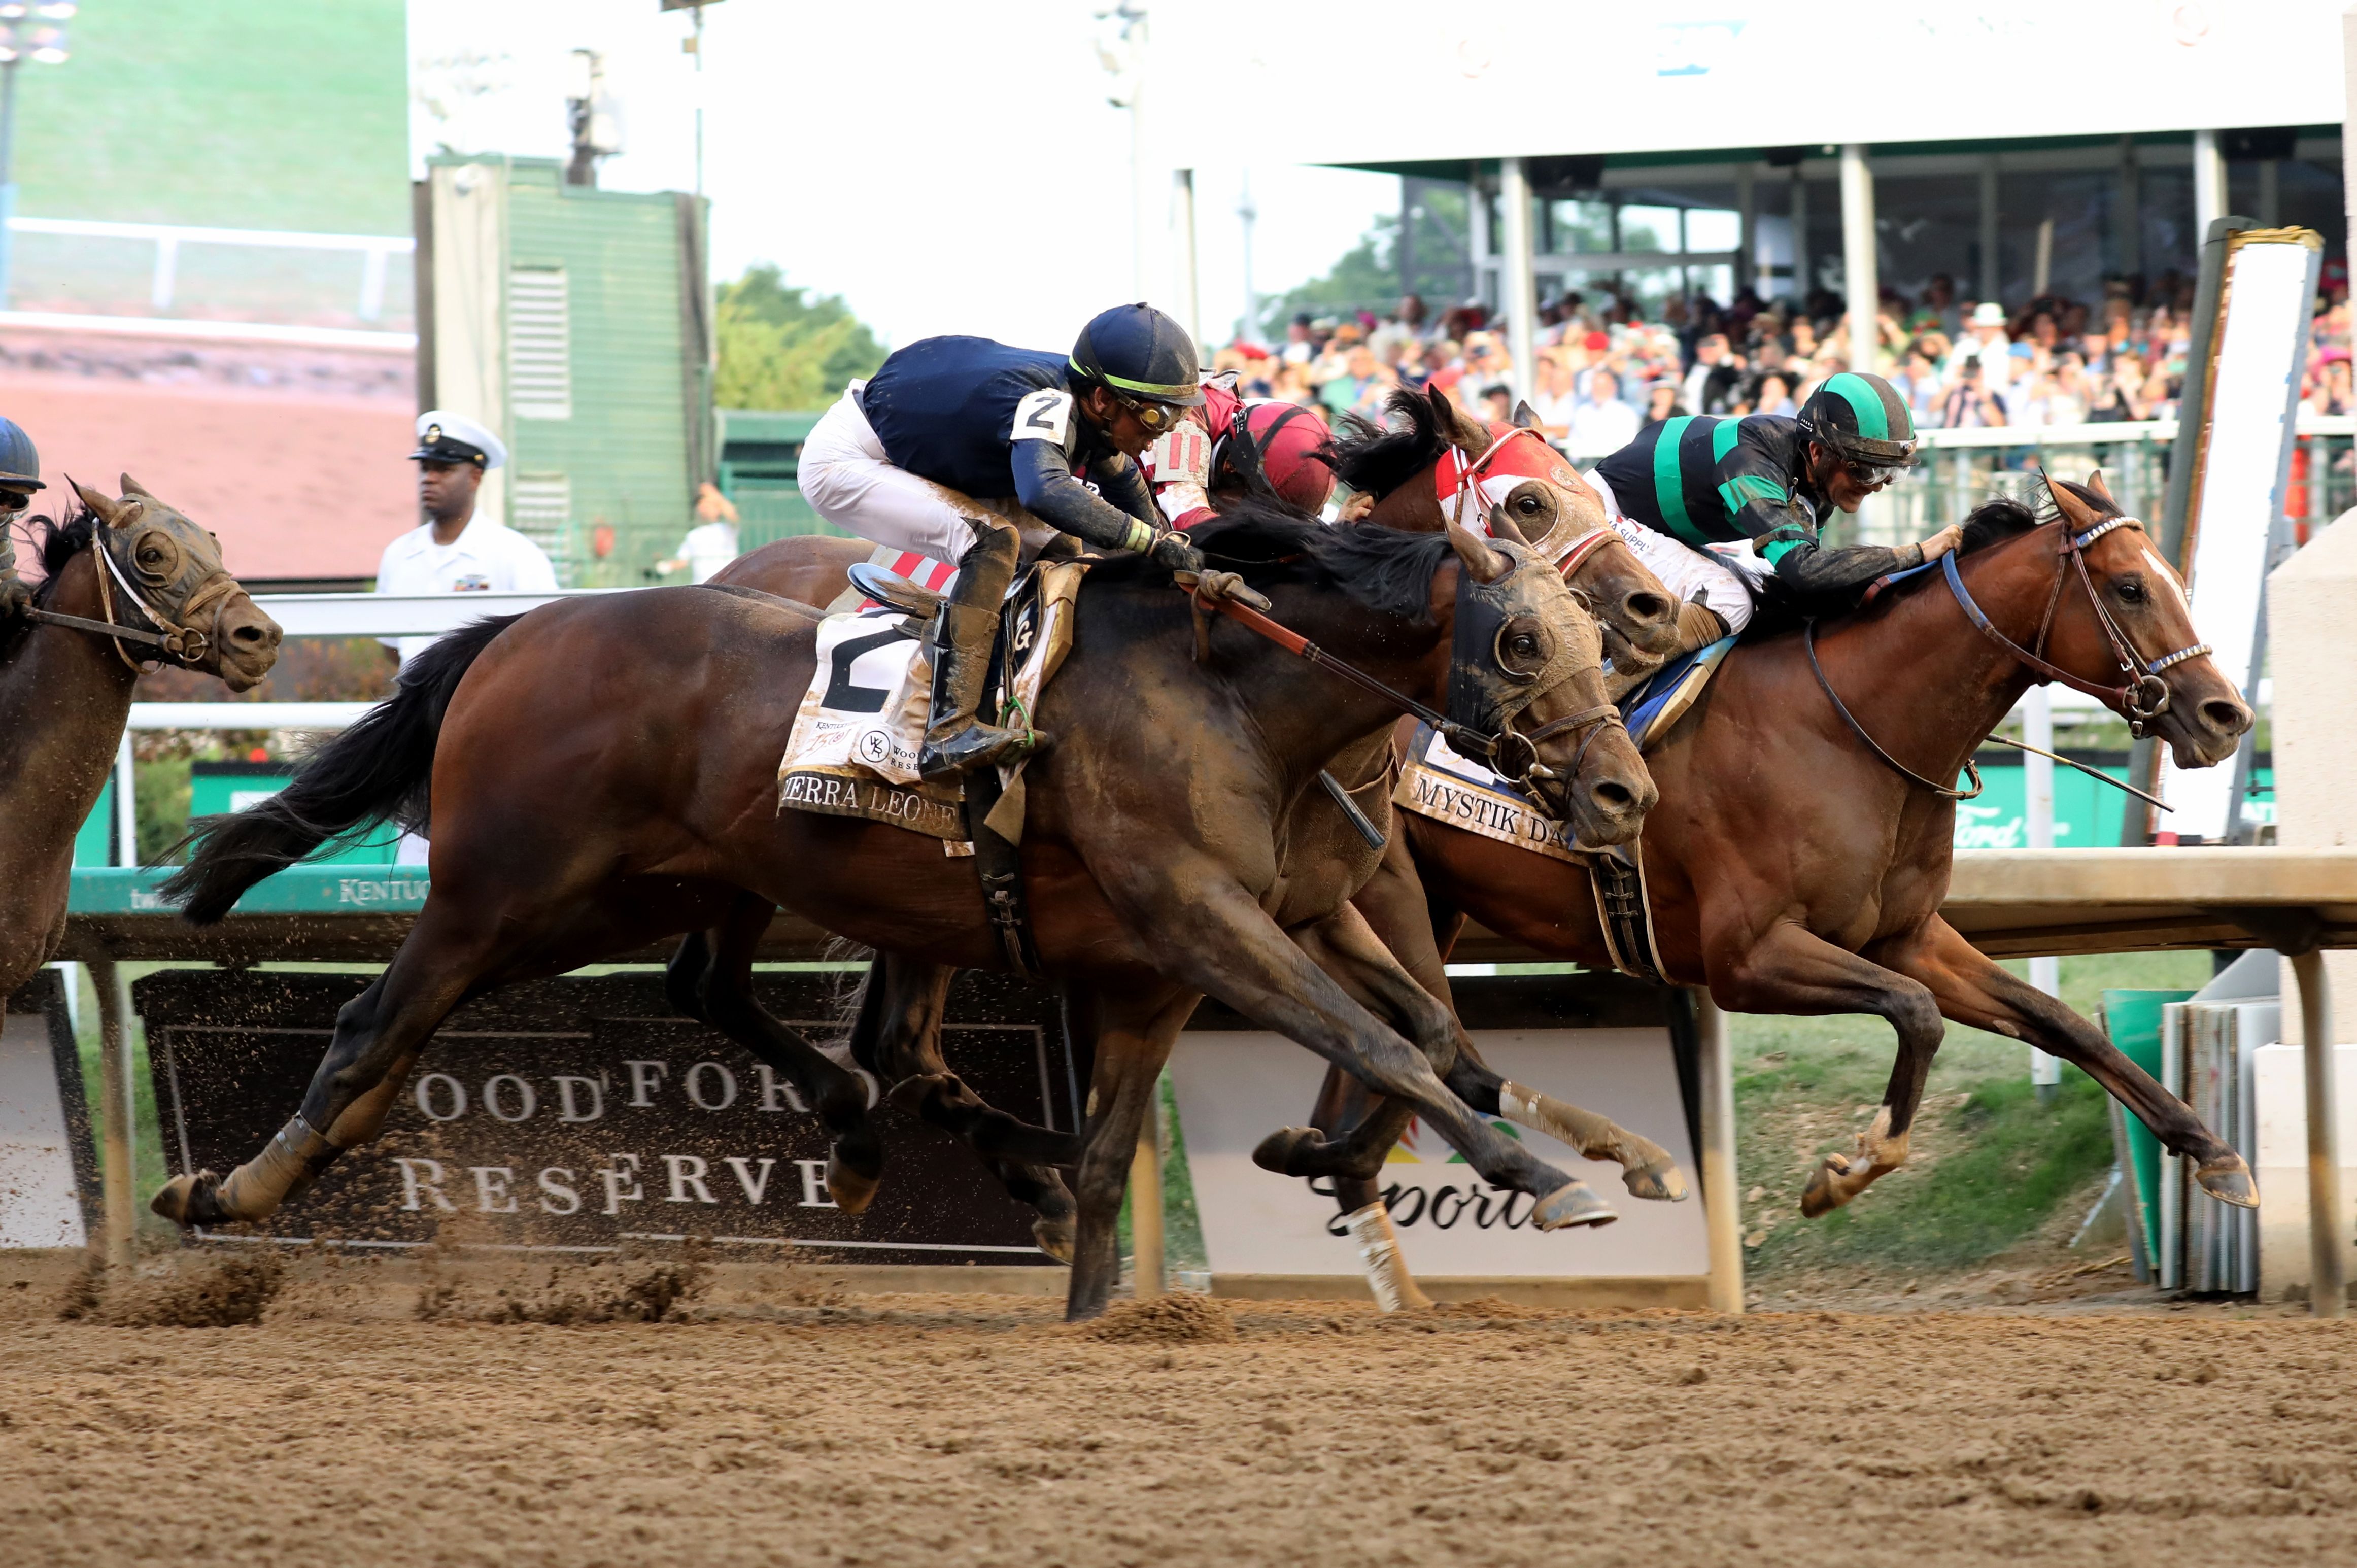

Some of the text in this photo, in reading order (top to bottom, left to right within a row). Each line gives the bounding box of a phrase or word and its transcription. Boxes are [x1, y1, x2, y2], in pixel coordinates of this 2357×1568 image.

[1026, 396, 1062, 430] 2
[1169, 433, 1201, 473] 11
[893, 745, 919, 759] WOO
[782, 776, 859, 808] IERRA
[1412, 777, 1520, 835] MYSTIK
[415, 1060, 879, 1122] OODFOR
[393, 1153, 840, 1215] RESERVE
